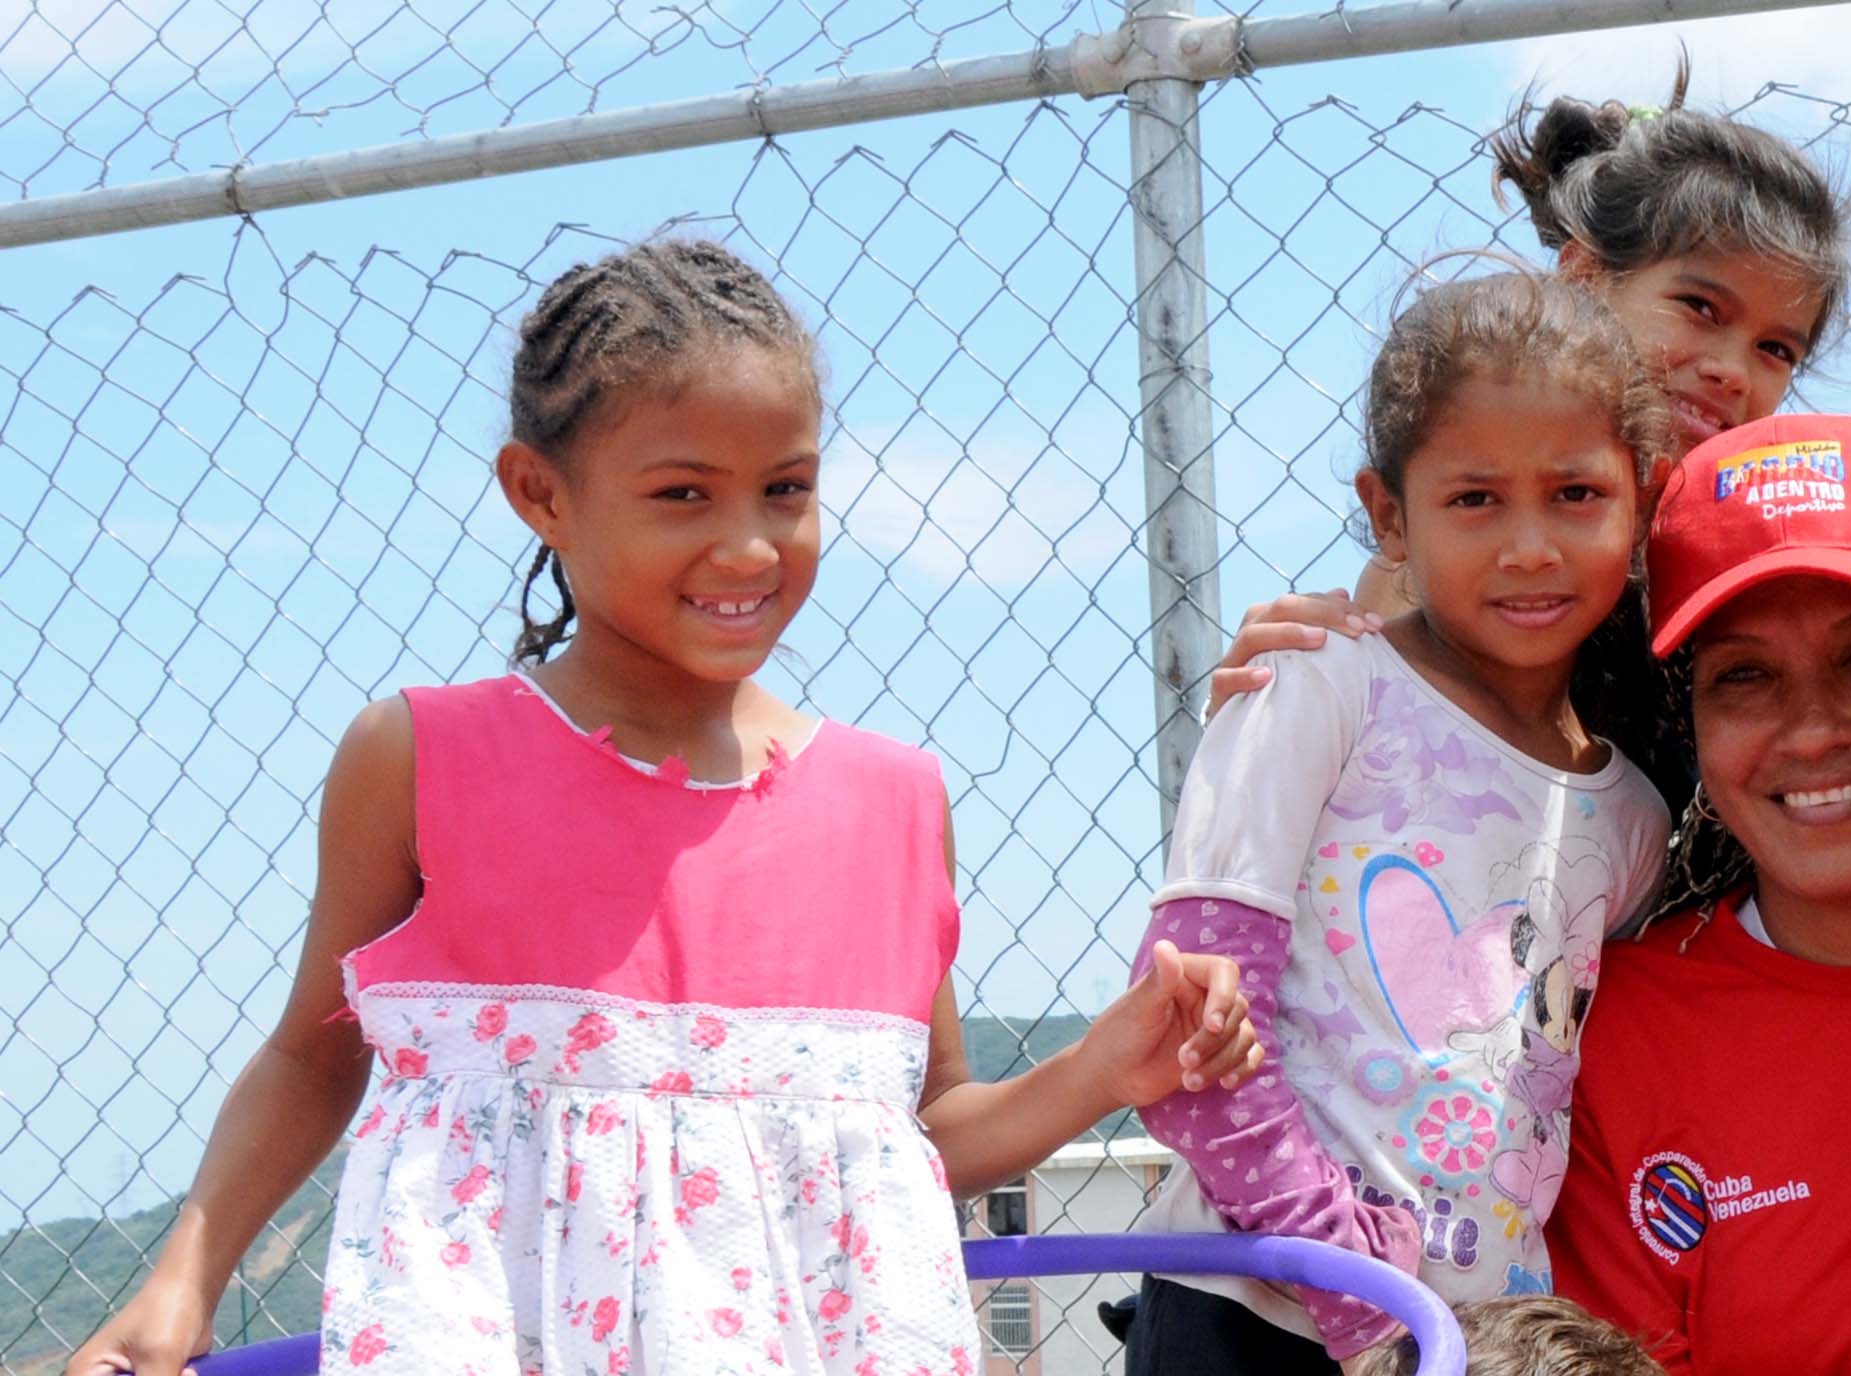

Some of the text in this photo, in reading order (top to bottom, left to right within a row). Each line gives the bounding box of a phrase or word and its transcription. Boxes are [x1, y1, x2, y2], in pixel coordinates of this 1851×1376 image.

[1747, 480, 1845, 504] ADENTRO
[1762, 499, 1846, 520] Deportivo
[1703, 1174, 1752, 1201] Cuba
[1628, 1150, 1708, 1266] Convenio Integral de Cooperación
[1707, 1180, 1811, 1223] Venezuela
